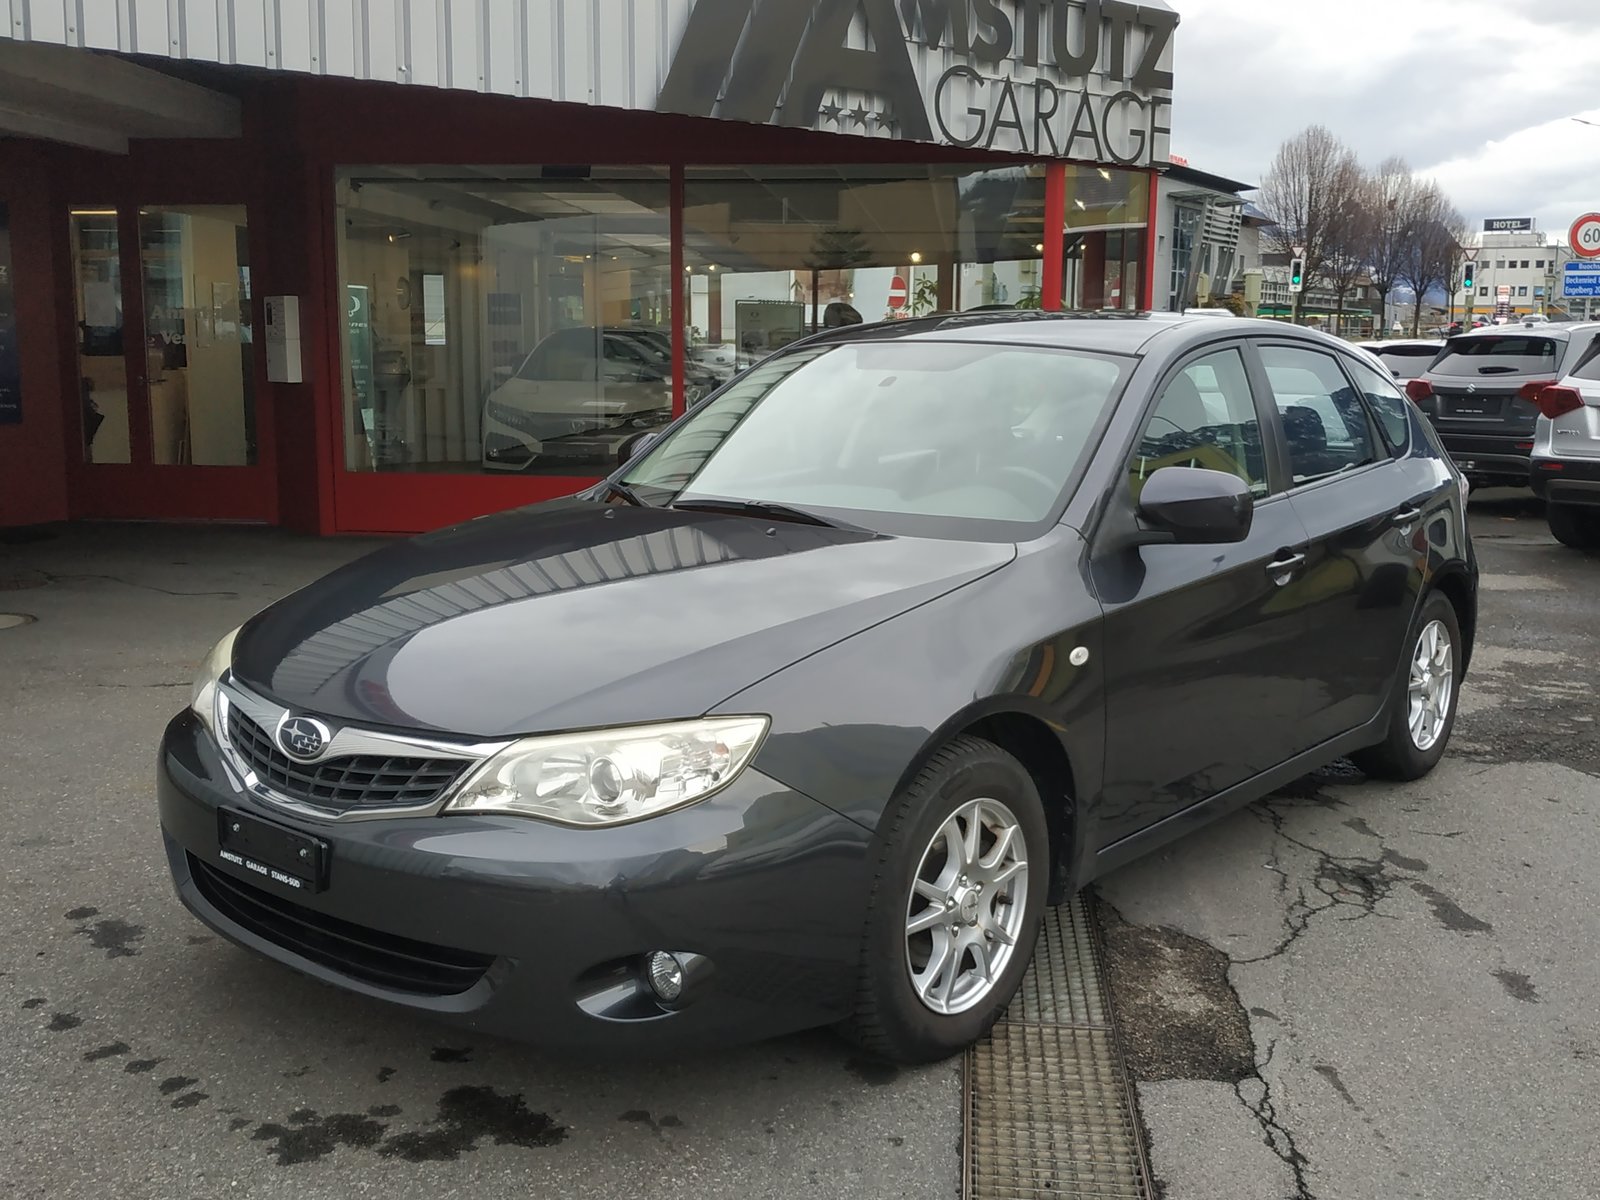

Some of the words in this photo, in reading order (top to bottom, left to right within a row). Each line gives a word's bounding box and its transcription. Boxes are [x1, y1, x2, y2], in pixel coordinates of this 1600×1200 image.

[935, 65, 1173, 168] GARAGE
[1493, 220, 1521, 229] HOTEL
[1583, 228, 1600, 243] 60
[1565, 286, 1593, 295] Engelberg
[220, 850, 243, 865] AMSTUTZ
[246, 861, 268, 875] GARAGE
